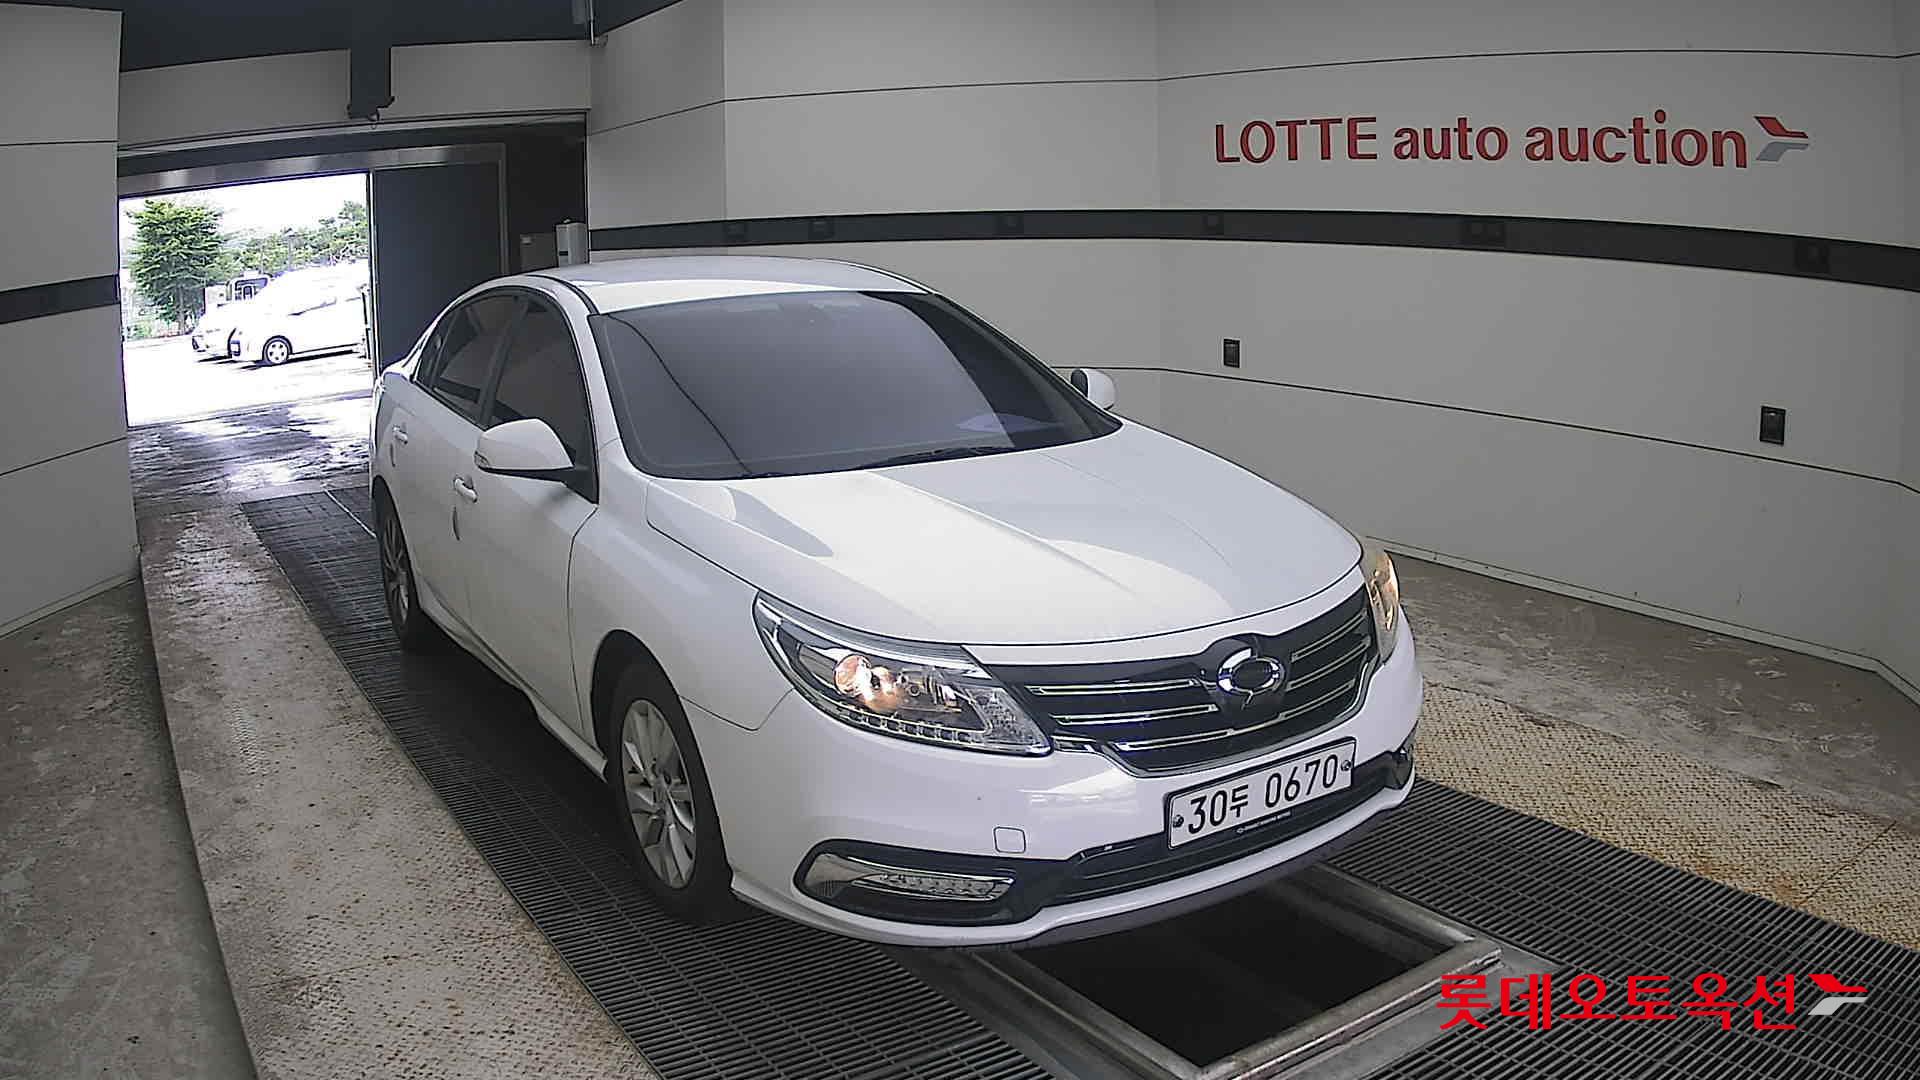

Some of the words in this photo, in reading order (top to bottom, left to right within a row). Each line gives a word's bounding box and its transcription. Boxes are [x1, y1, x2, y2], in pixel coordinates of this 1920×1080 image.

[1215, 116, 1377, 163] LOTTE
[1393, 116, 1509, 162] auto
[1525, 109, 1748, 169] auction
[1188, 784, 1249, 834] 30두
[1264, 754, 1339, 809] 0670
